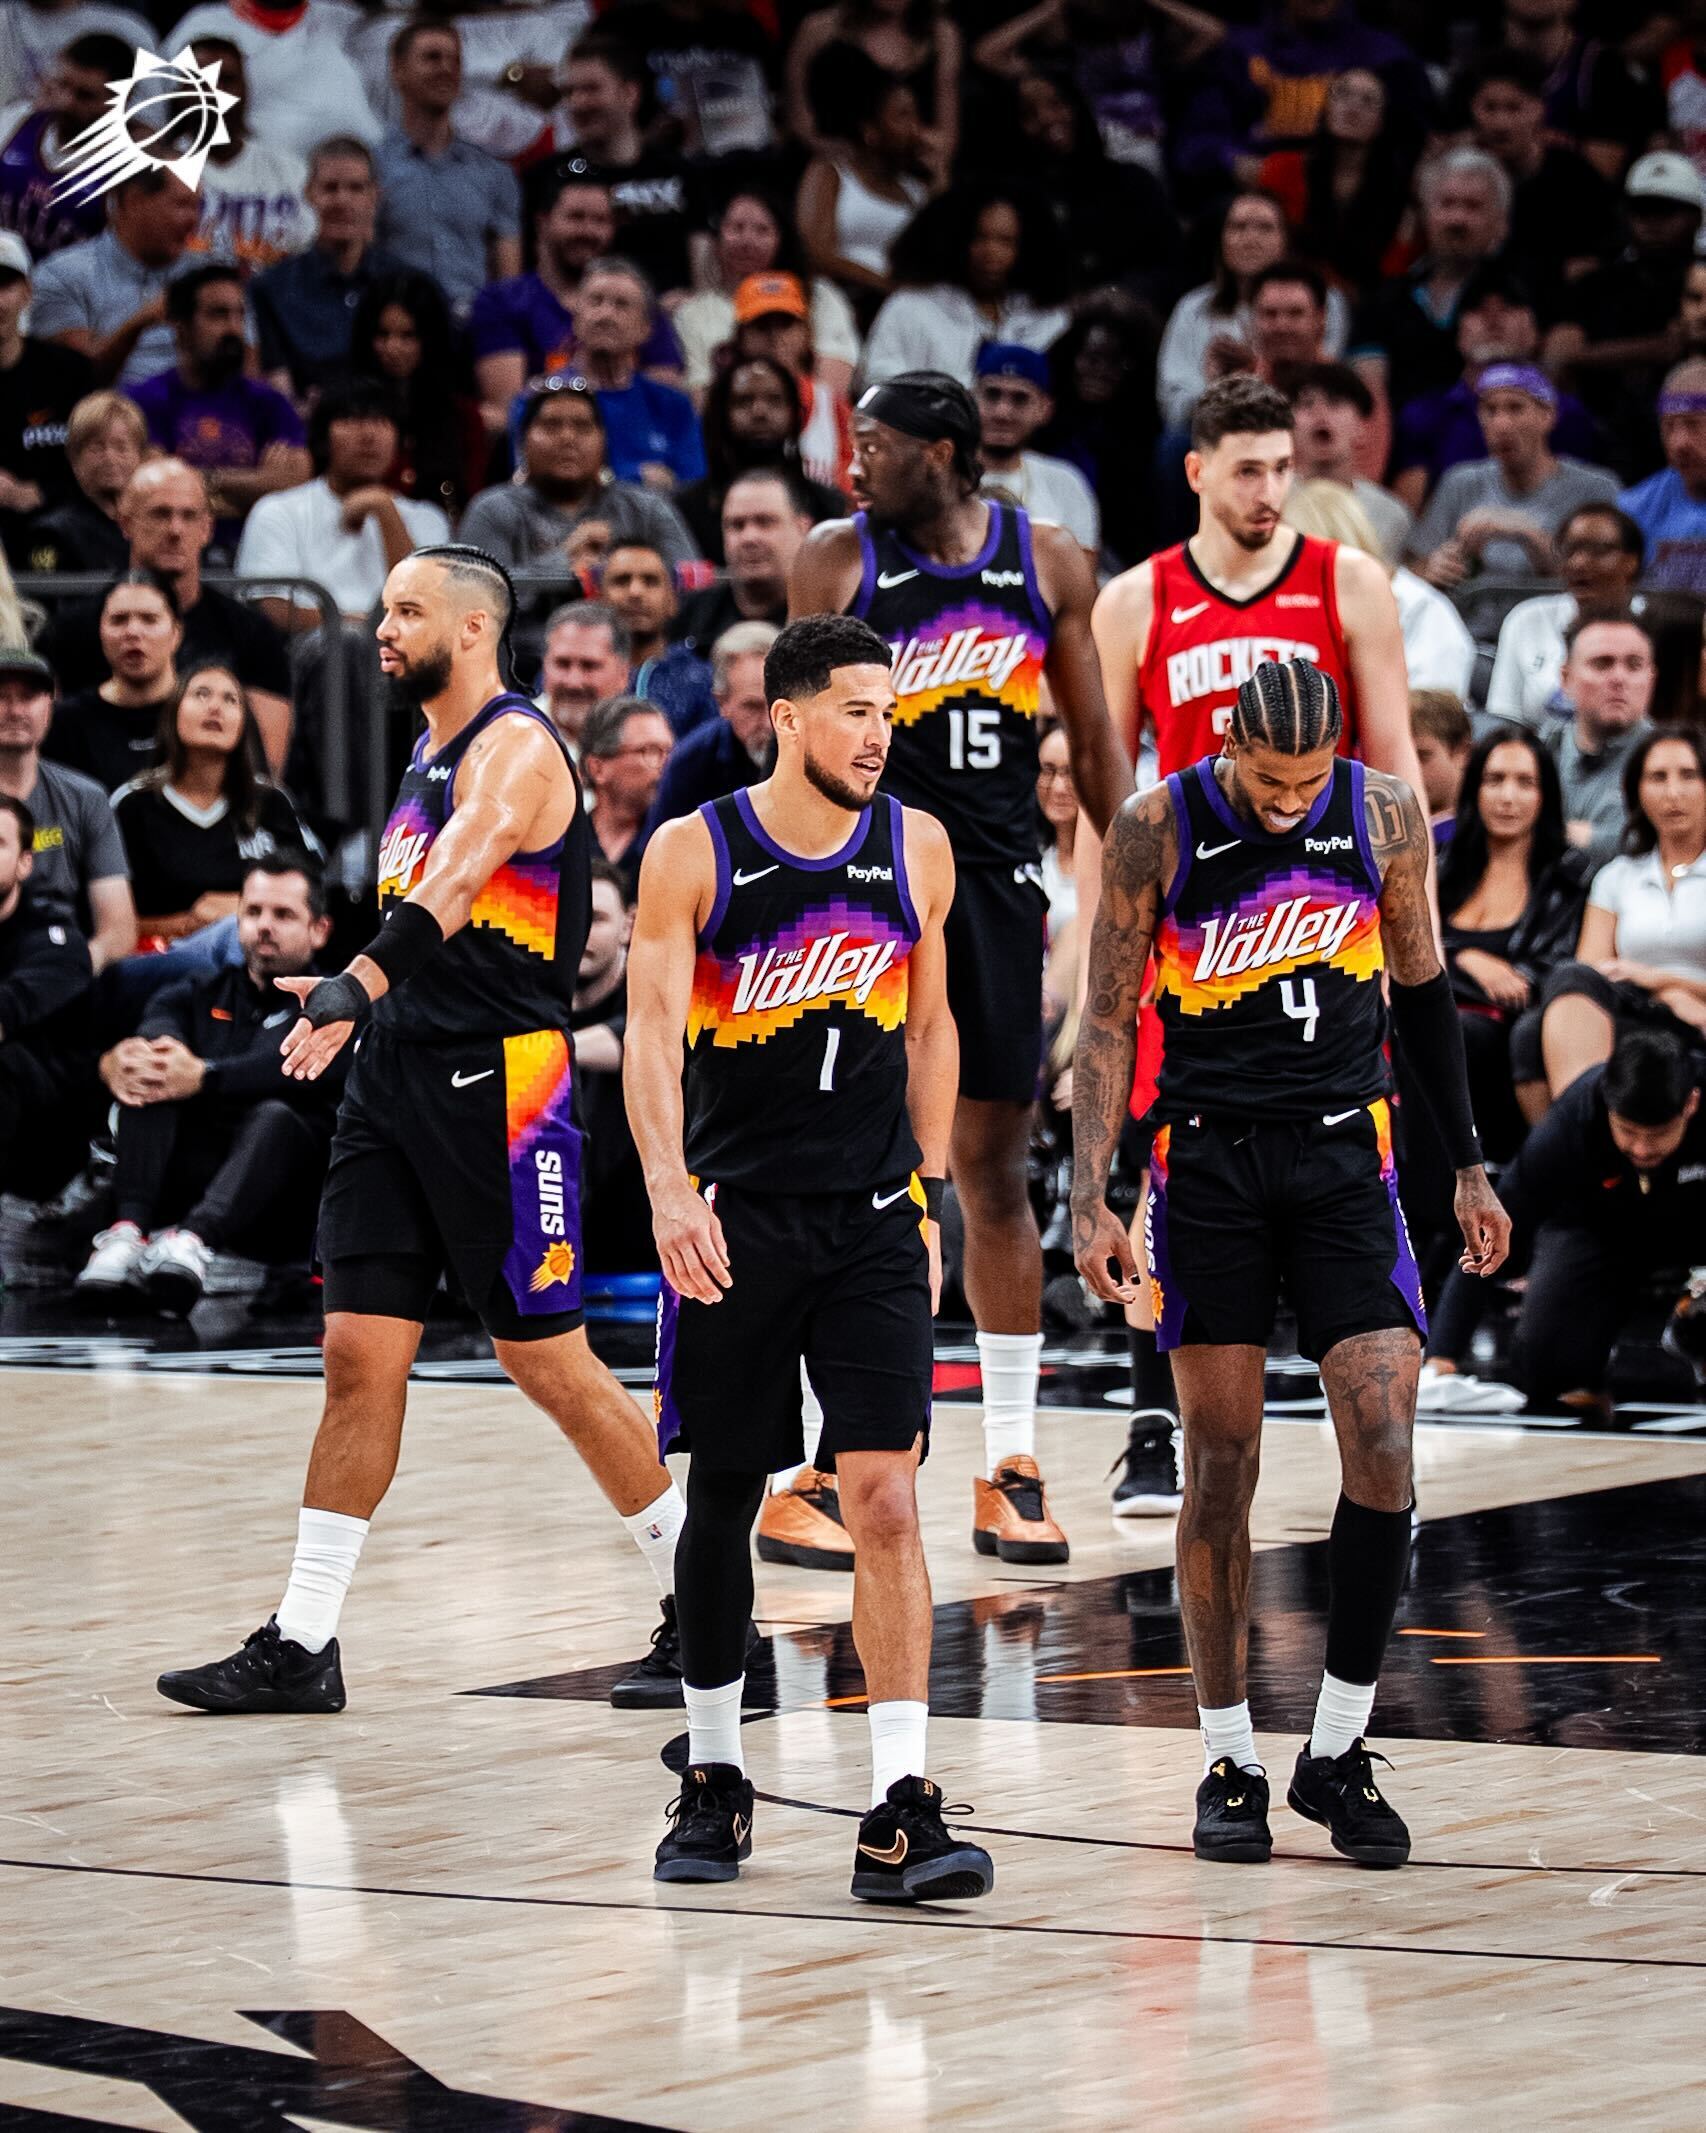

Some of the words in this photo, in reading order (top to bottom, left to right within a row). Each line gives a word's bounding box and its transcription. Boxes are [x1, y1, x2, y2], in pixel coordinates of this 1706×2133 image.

[980, 569, 1024, 588] PayPal
[888, 626, 1028, 697] Valley
[948, 709, 1002, 769] 15
[847, 865, 893, 883] PayPal
[1305, 836, 1353, 855] PayPal
[1193, 895, 1361, 983] Valley
[1237, 911, 1269, 932] THE
[731, 931, 898, 1014] Valley
[774, 947, 807, 968] THE
[1278, 977, 1320, 1042] 4
[819, 1027, 841, 1091] 1
[535, 1149, 566, 1236] SUNS
